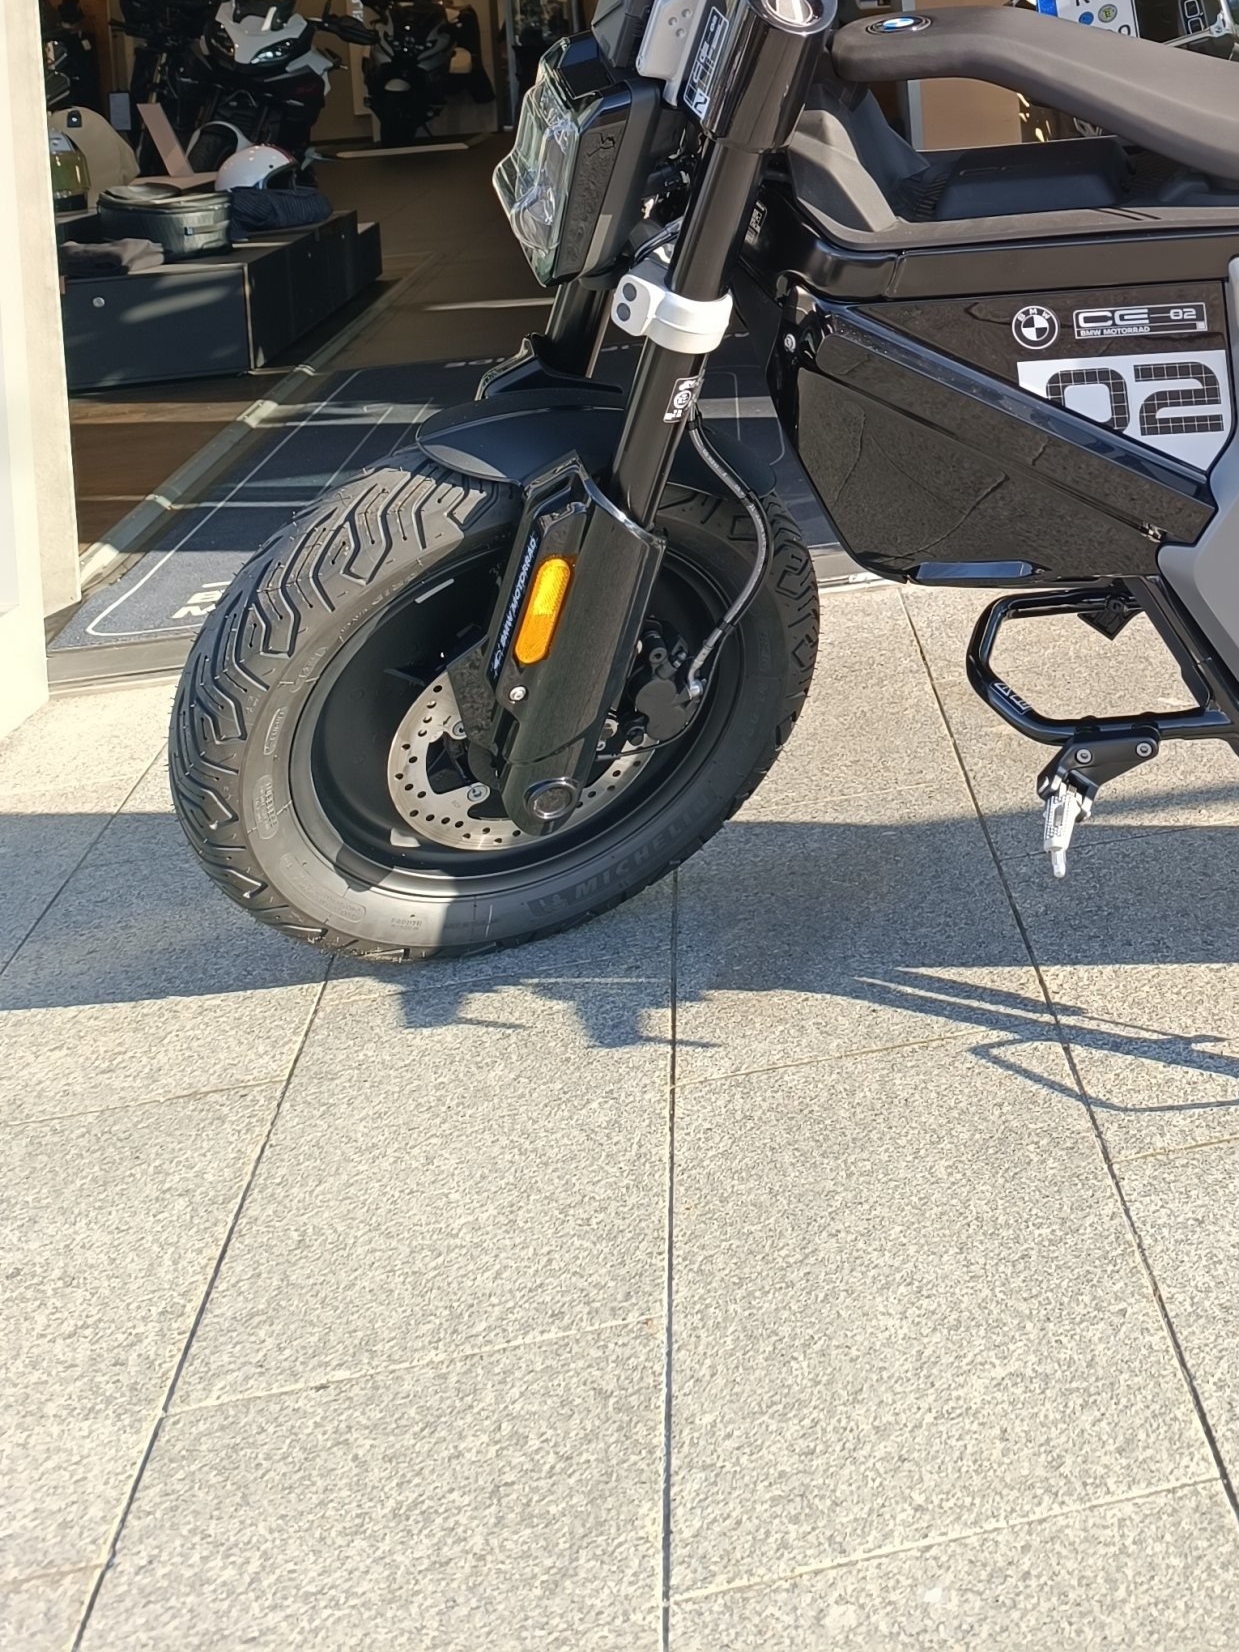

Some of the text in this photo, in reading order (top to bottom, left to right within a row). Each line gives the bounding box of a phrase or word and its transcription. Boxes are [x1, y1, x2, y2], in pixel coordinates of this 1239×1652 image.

[1079, 308, 1149, 328] CE
[1080, 326, 1150, 337] BMW MOTORRAD
[1046, 361, 1225, 436] 02
